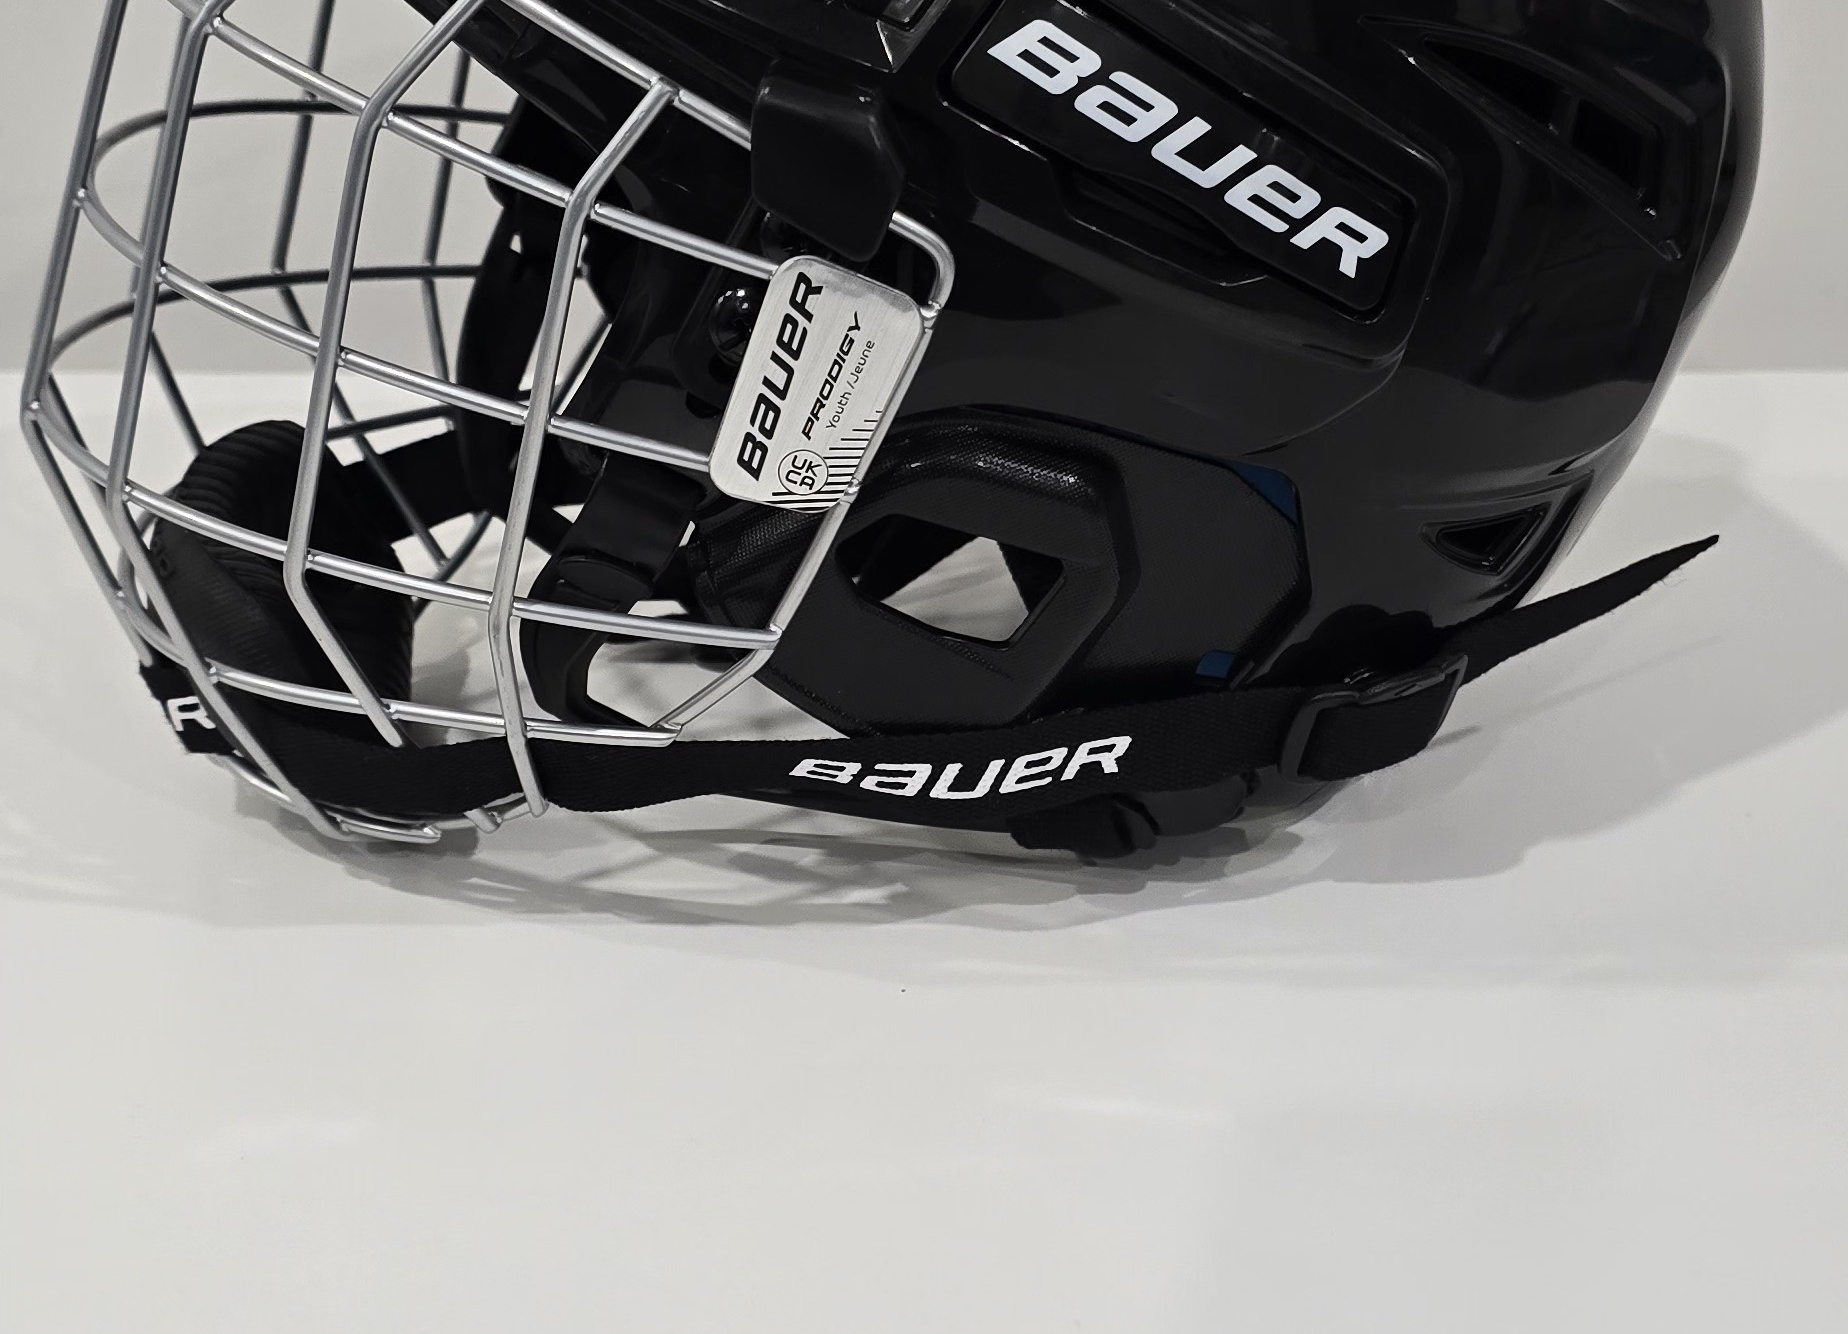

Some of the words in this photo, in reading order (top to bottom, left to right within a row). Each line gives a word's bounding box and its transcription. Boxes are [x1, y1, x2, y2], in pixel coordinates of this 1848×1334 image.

[986, 19, 1390, 279] BAUER
[736, 271, 824, 482] BAUER
[801, 310, 862, 441] PRODIGY
[826, 391, 852, 430] Youth
[789, 735, 1132, 800] BAUER
